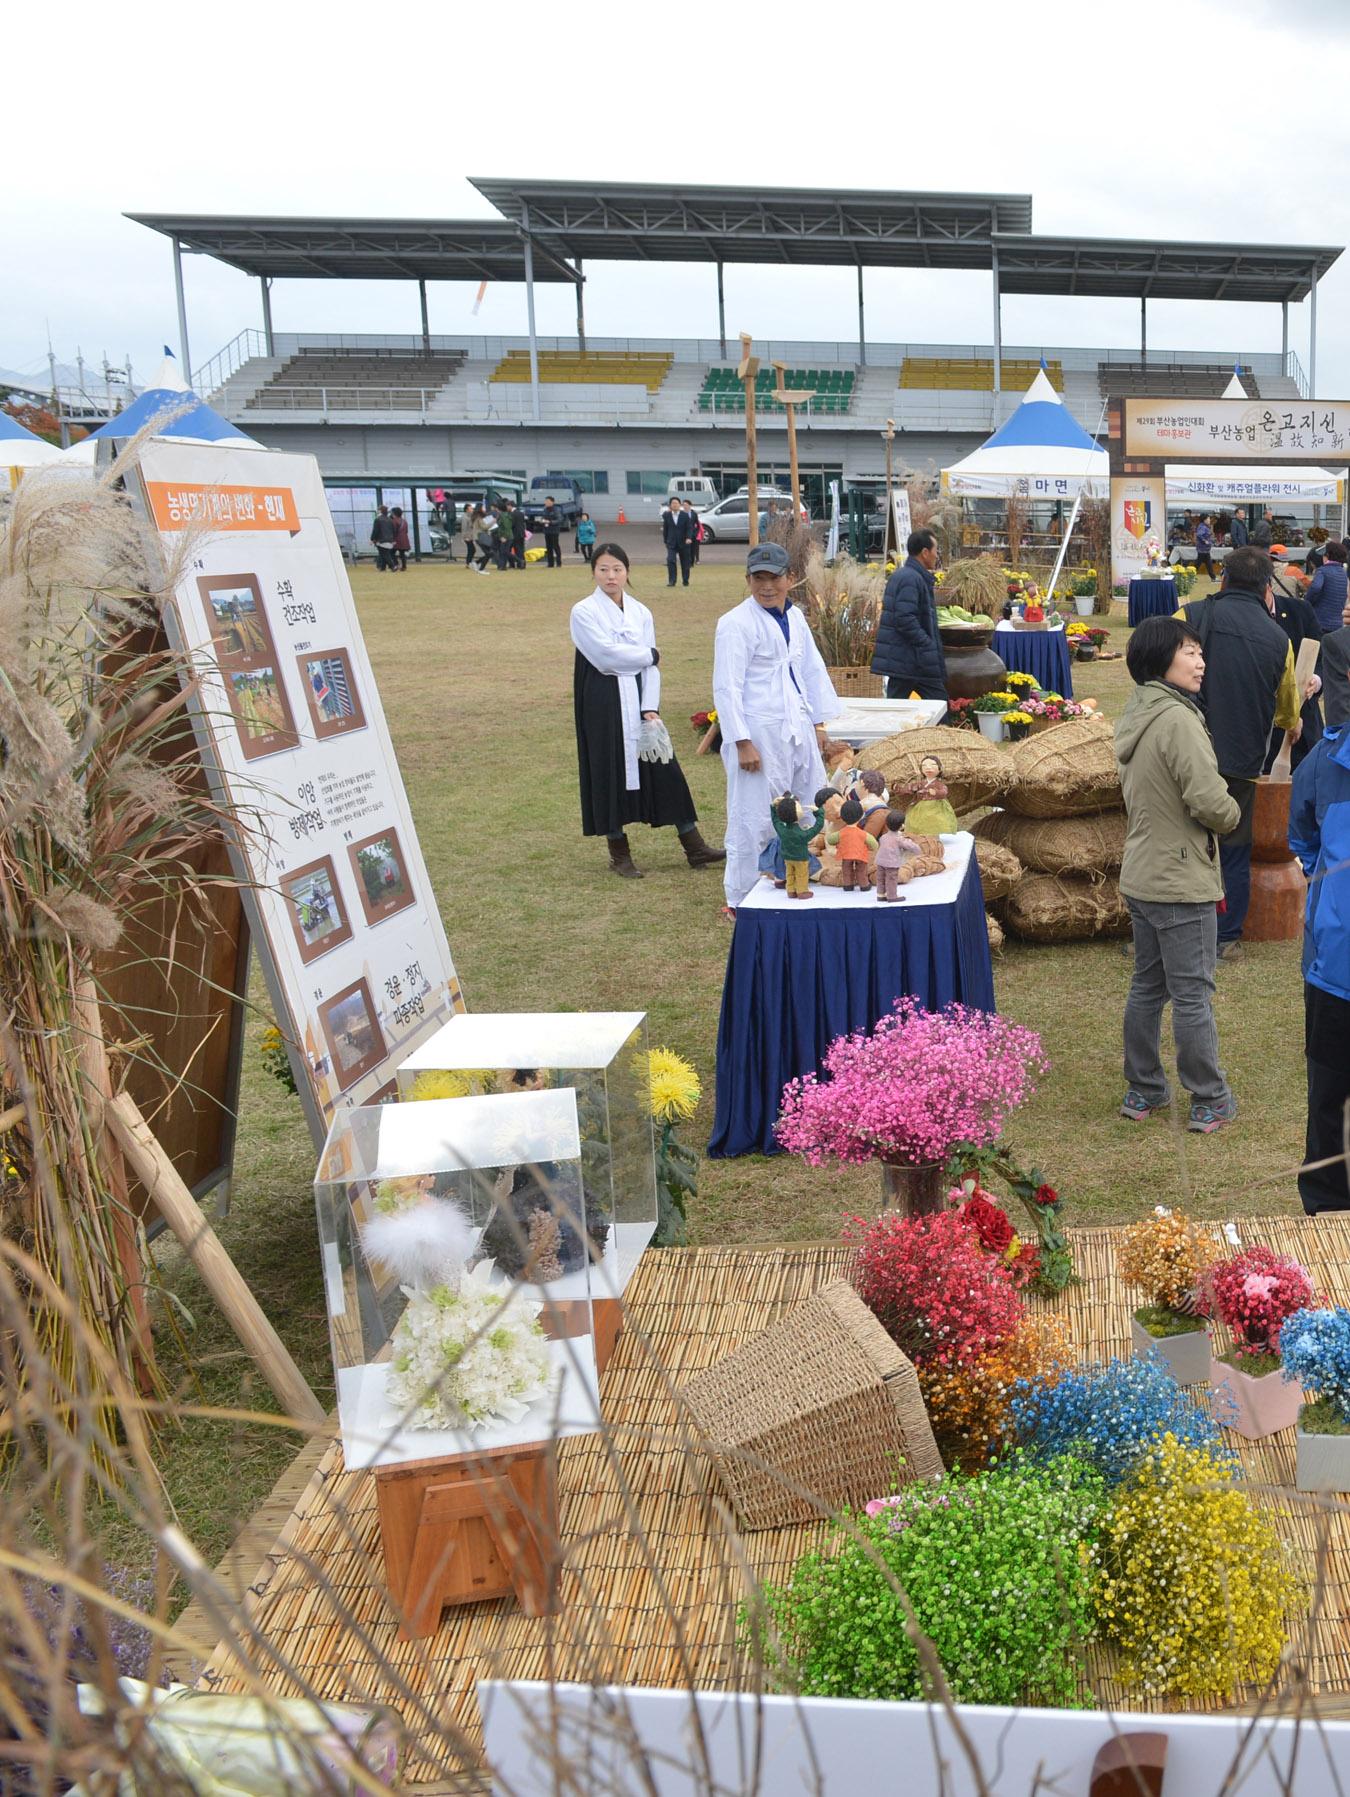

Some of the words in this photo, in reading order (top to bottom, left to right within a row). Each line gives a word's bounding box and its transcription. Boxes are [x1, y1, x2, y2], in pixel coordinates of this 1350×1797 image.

[1136, 417, 1155, 426] 제29회
[1157, 416, 1205, 427] 부산농업인대회
[1208, 424, 1257, 442] 부산농업
[1258, 410, 1336, 435] 온고지신
[1157, 428, 1192, 440] 테마홍보관
[1188, 481, 1215, 493] 신화환
[1217, 484, 1224, 493] 및
[1226, 482, 1281, 495] 캐쥬얼플라워
[1283, 483, 1301, 495] 전시
[264, 494, 286, 521] 현재
[277, 579, 295, 602] 수확
[282, 602, 317, 626] 건조작업
[297, 780, 317, 806] 이양
[393, 992, 425, 1028] 파종작업
